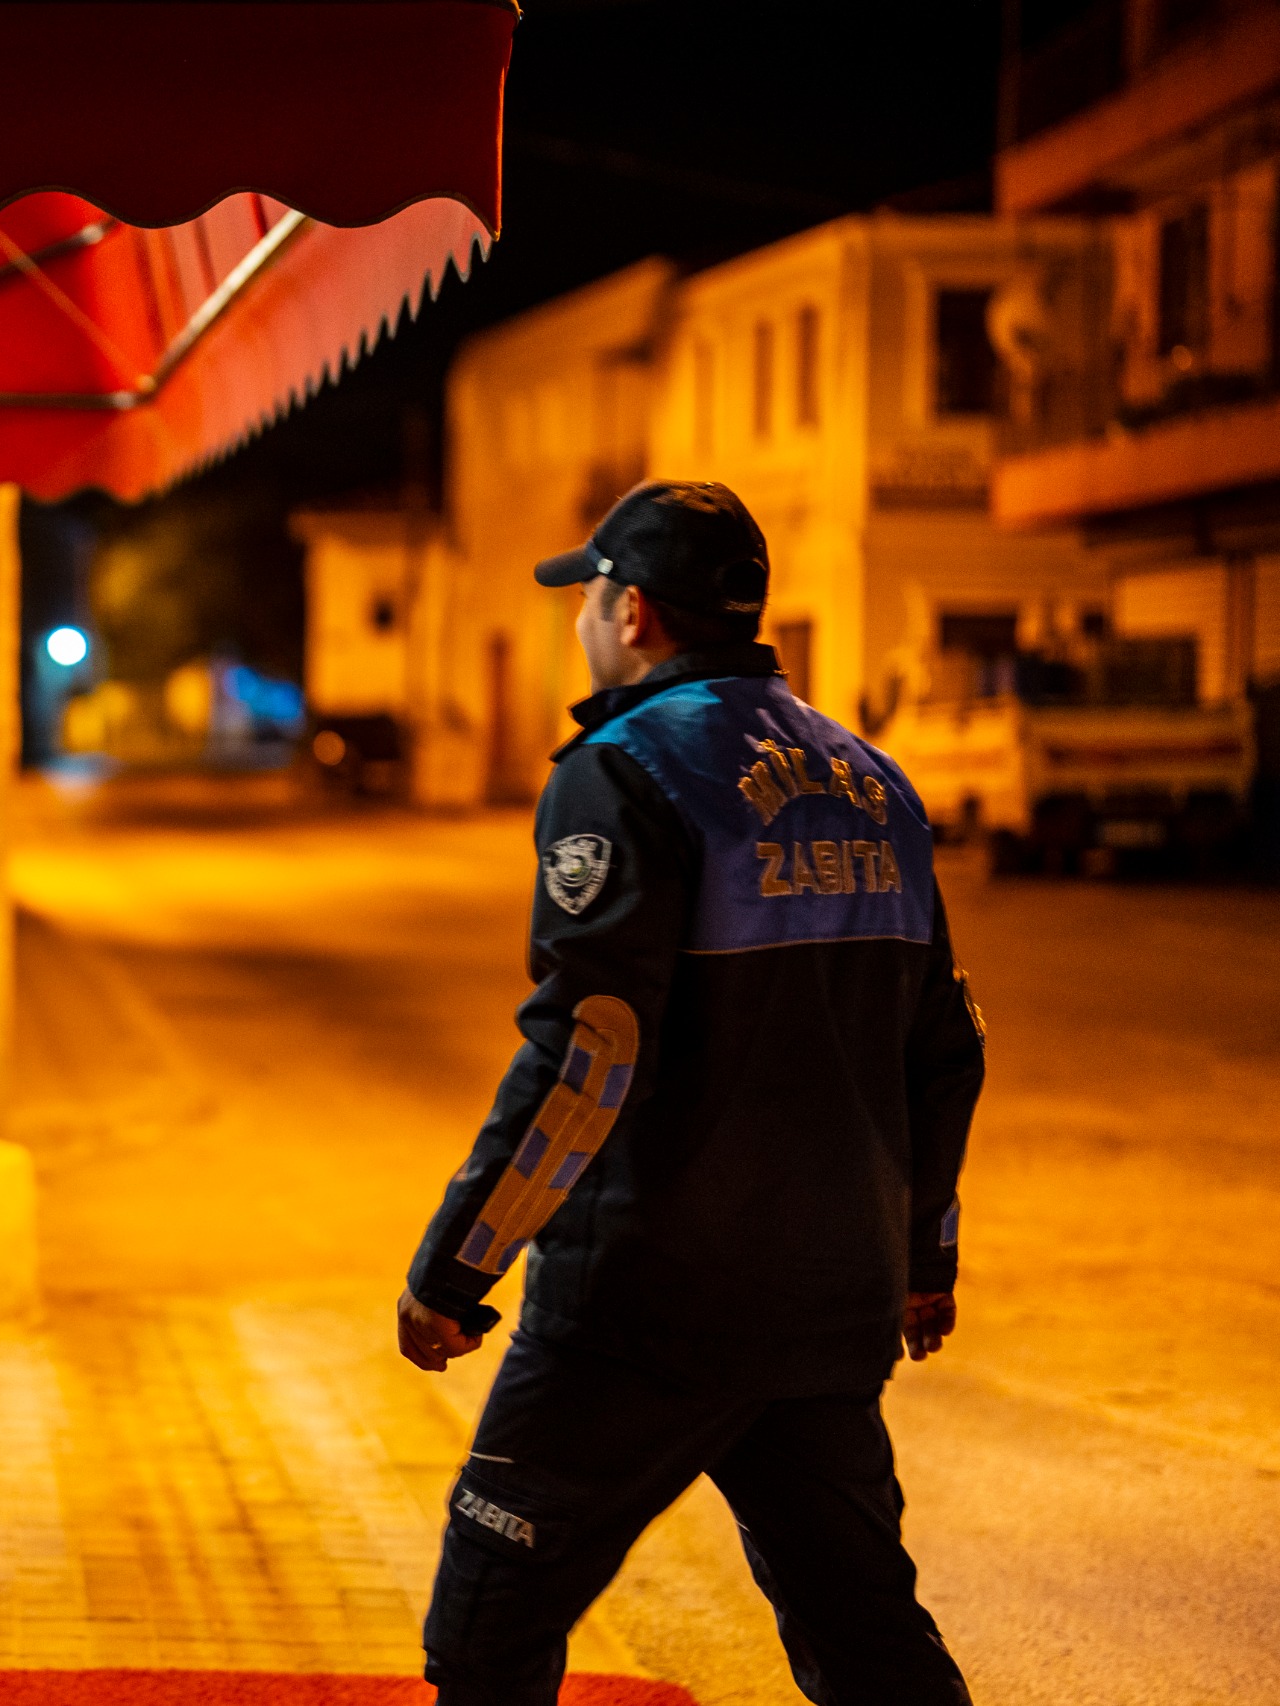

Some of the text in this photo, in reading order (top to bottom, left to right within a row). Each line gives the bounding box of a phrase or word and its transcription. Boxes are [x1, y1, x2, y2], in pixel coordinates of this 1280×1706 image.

[738, 738, 888, 826] MİLAS
[756, 840, 902, 898] ZABITA
[454, 1488, 537, 1548] ZABITA
